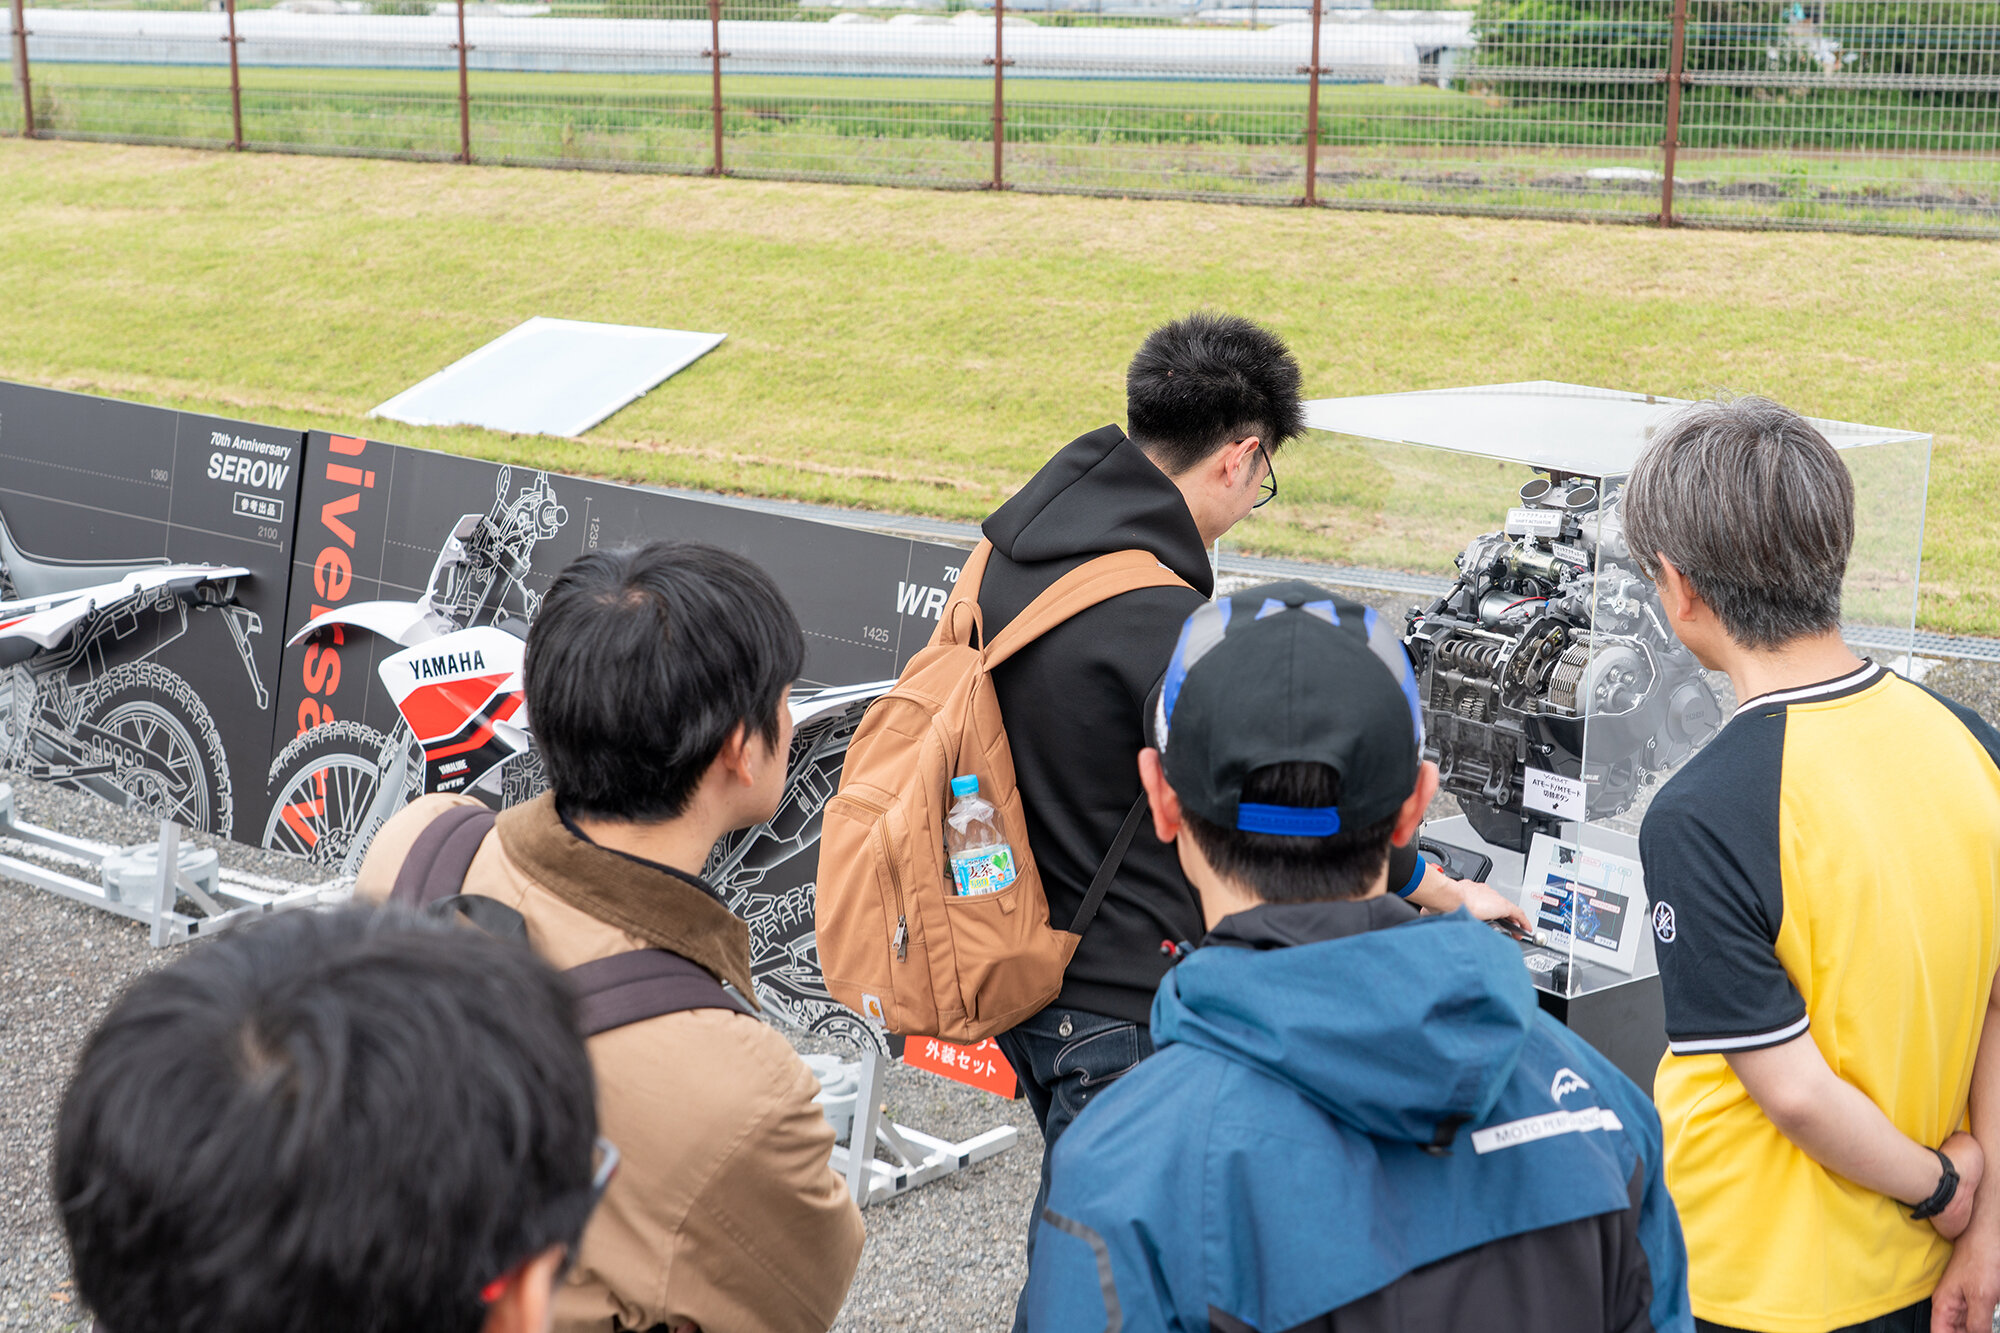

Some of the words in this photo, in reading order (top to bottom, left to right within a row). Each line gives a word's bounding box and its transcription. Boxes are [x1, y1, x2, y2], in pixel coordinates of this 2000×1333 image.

[210, 431, 231, 447] 70th
[232, 435, 292, 461] Anniversary
[207, 452, 290, 491] SEROW
[257, 525, 278, 540] 2100
[588, 516, 600, 549] 1235
[862, 625, 890, 643] 1425
[408, 649, 486, 680] YAMAHA
[350, 815, 386, 875] YAMAHA
[925, 1039, 997, 1078] 外装セット
[1494, 1121, 1542, 1143] MOTO
